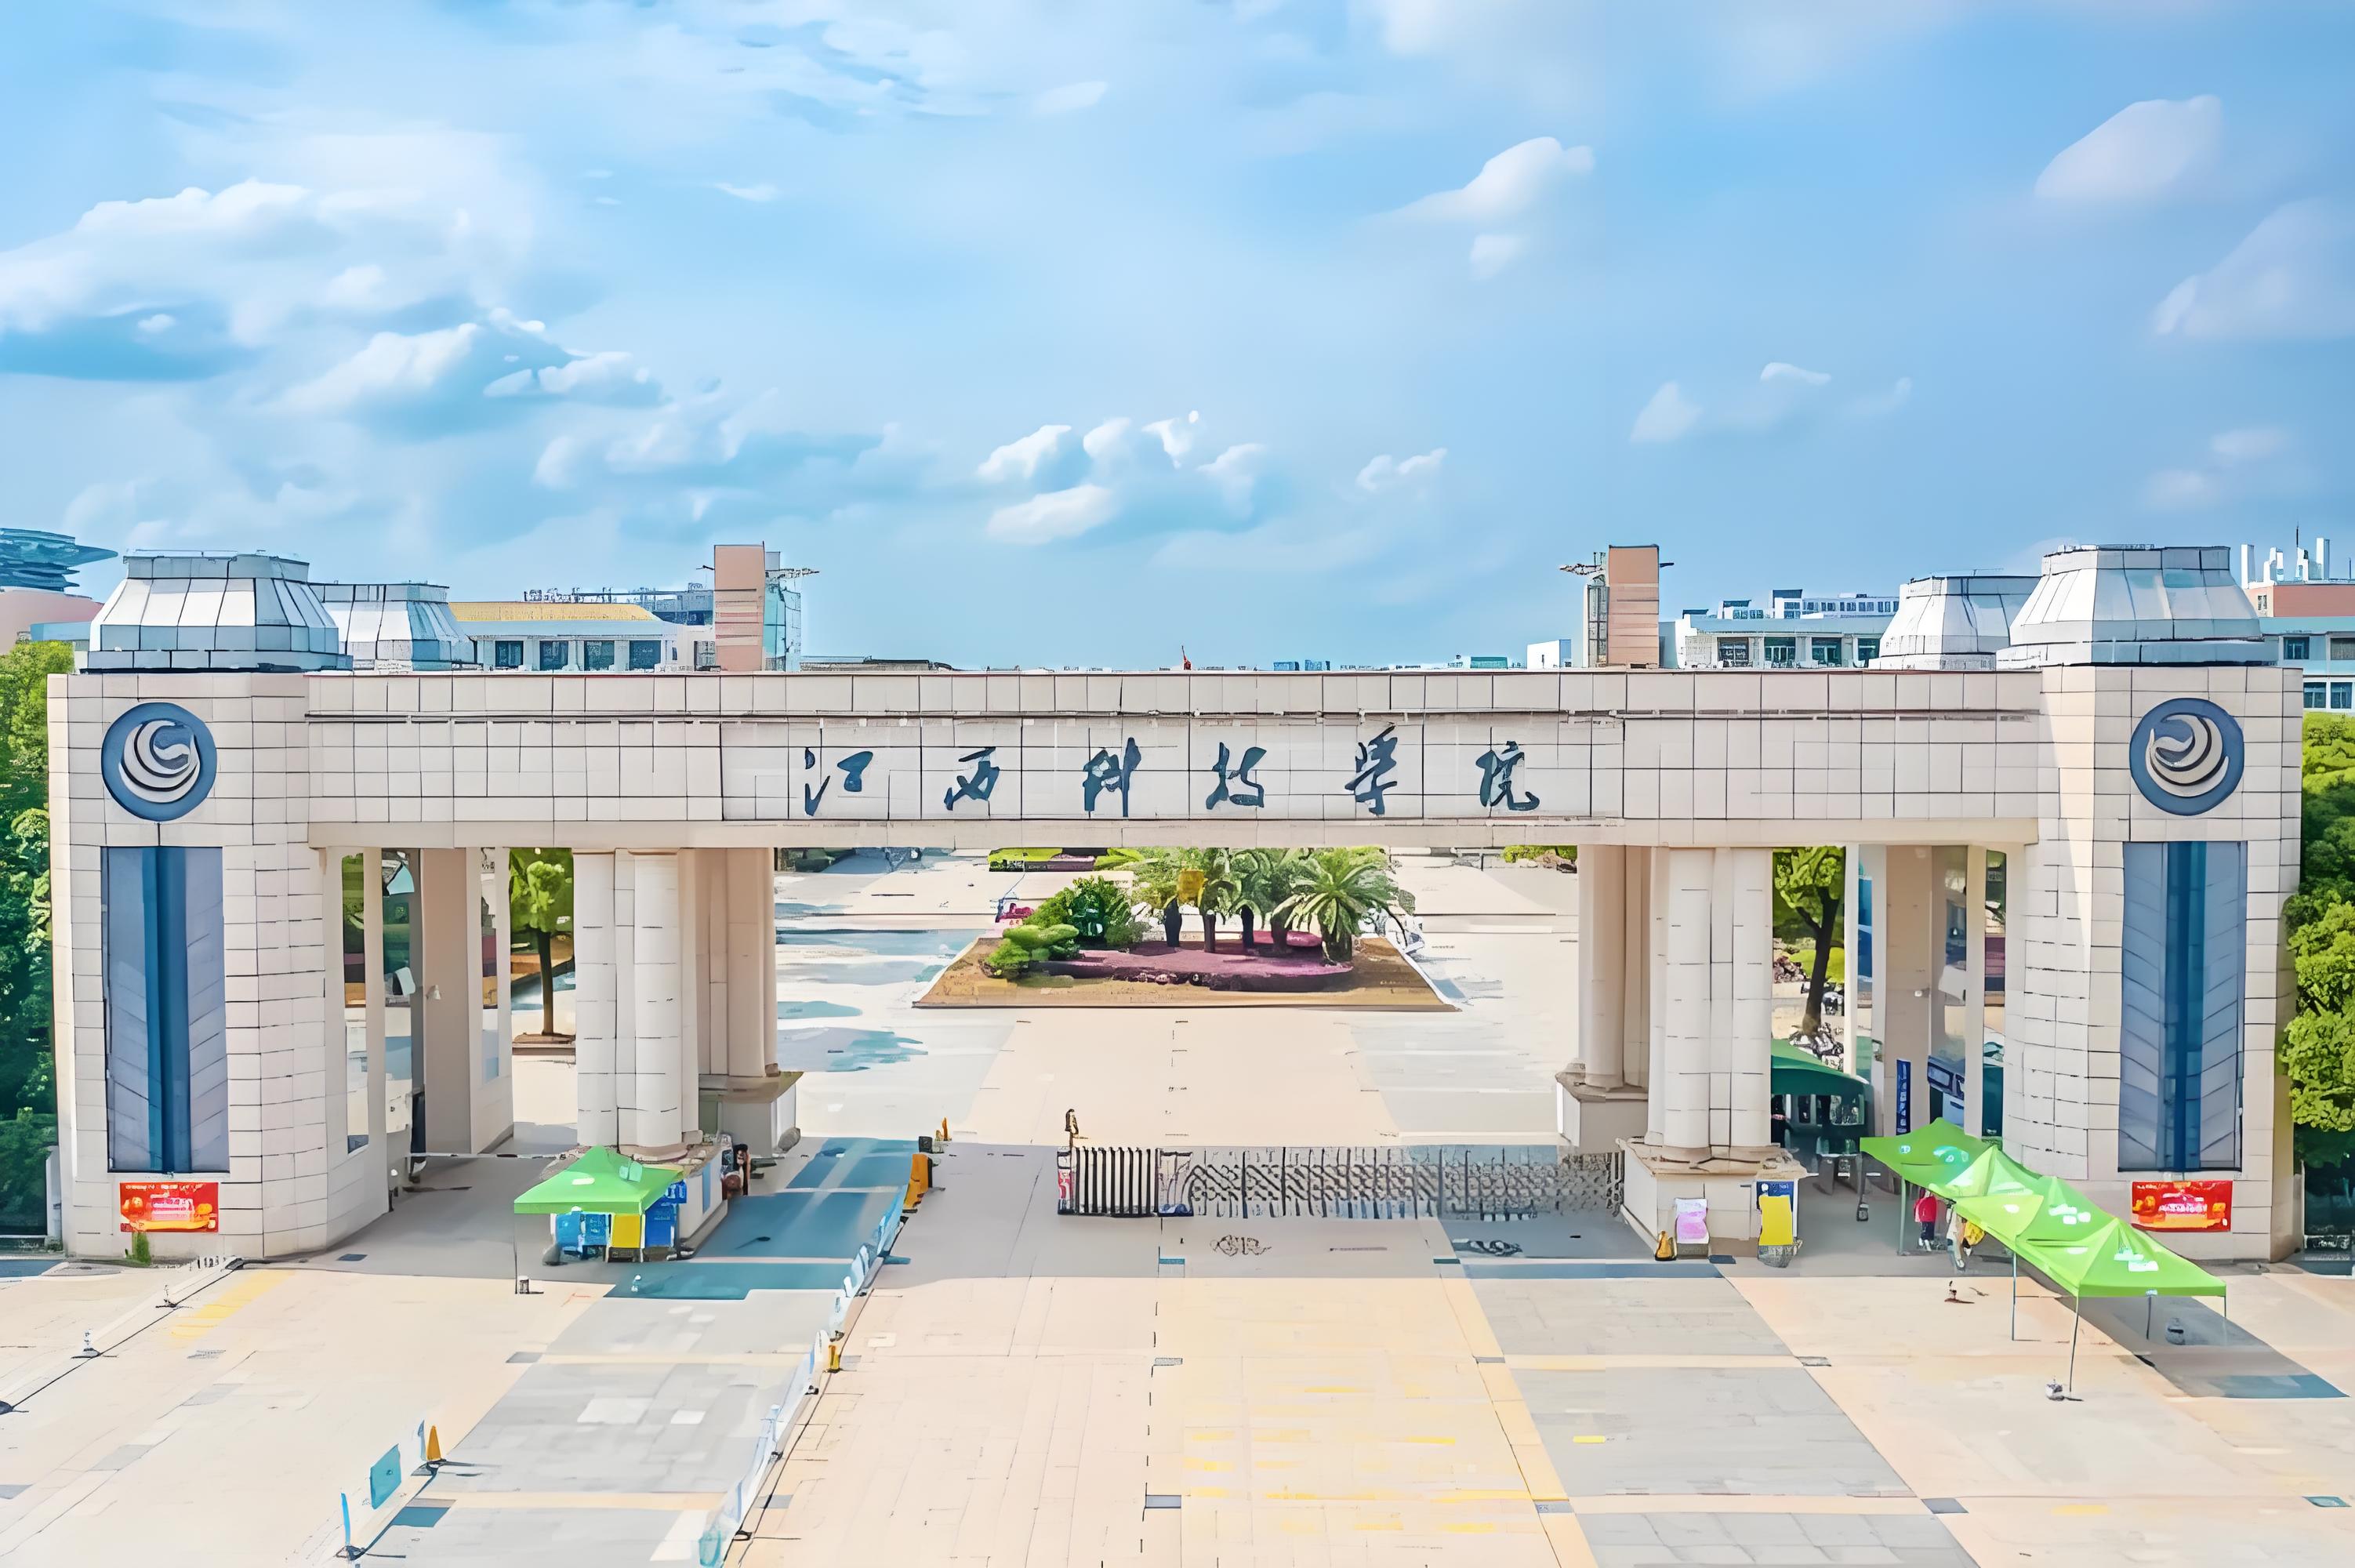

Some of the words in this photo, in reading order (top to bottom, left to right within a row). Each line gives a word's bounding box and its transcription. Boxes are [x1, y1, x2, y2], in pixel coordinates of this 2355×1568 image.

[804, 726, 1540, 817] 江西科技学院
